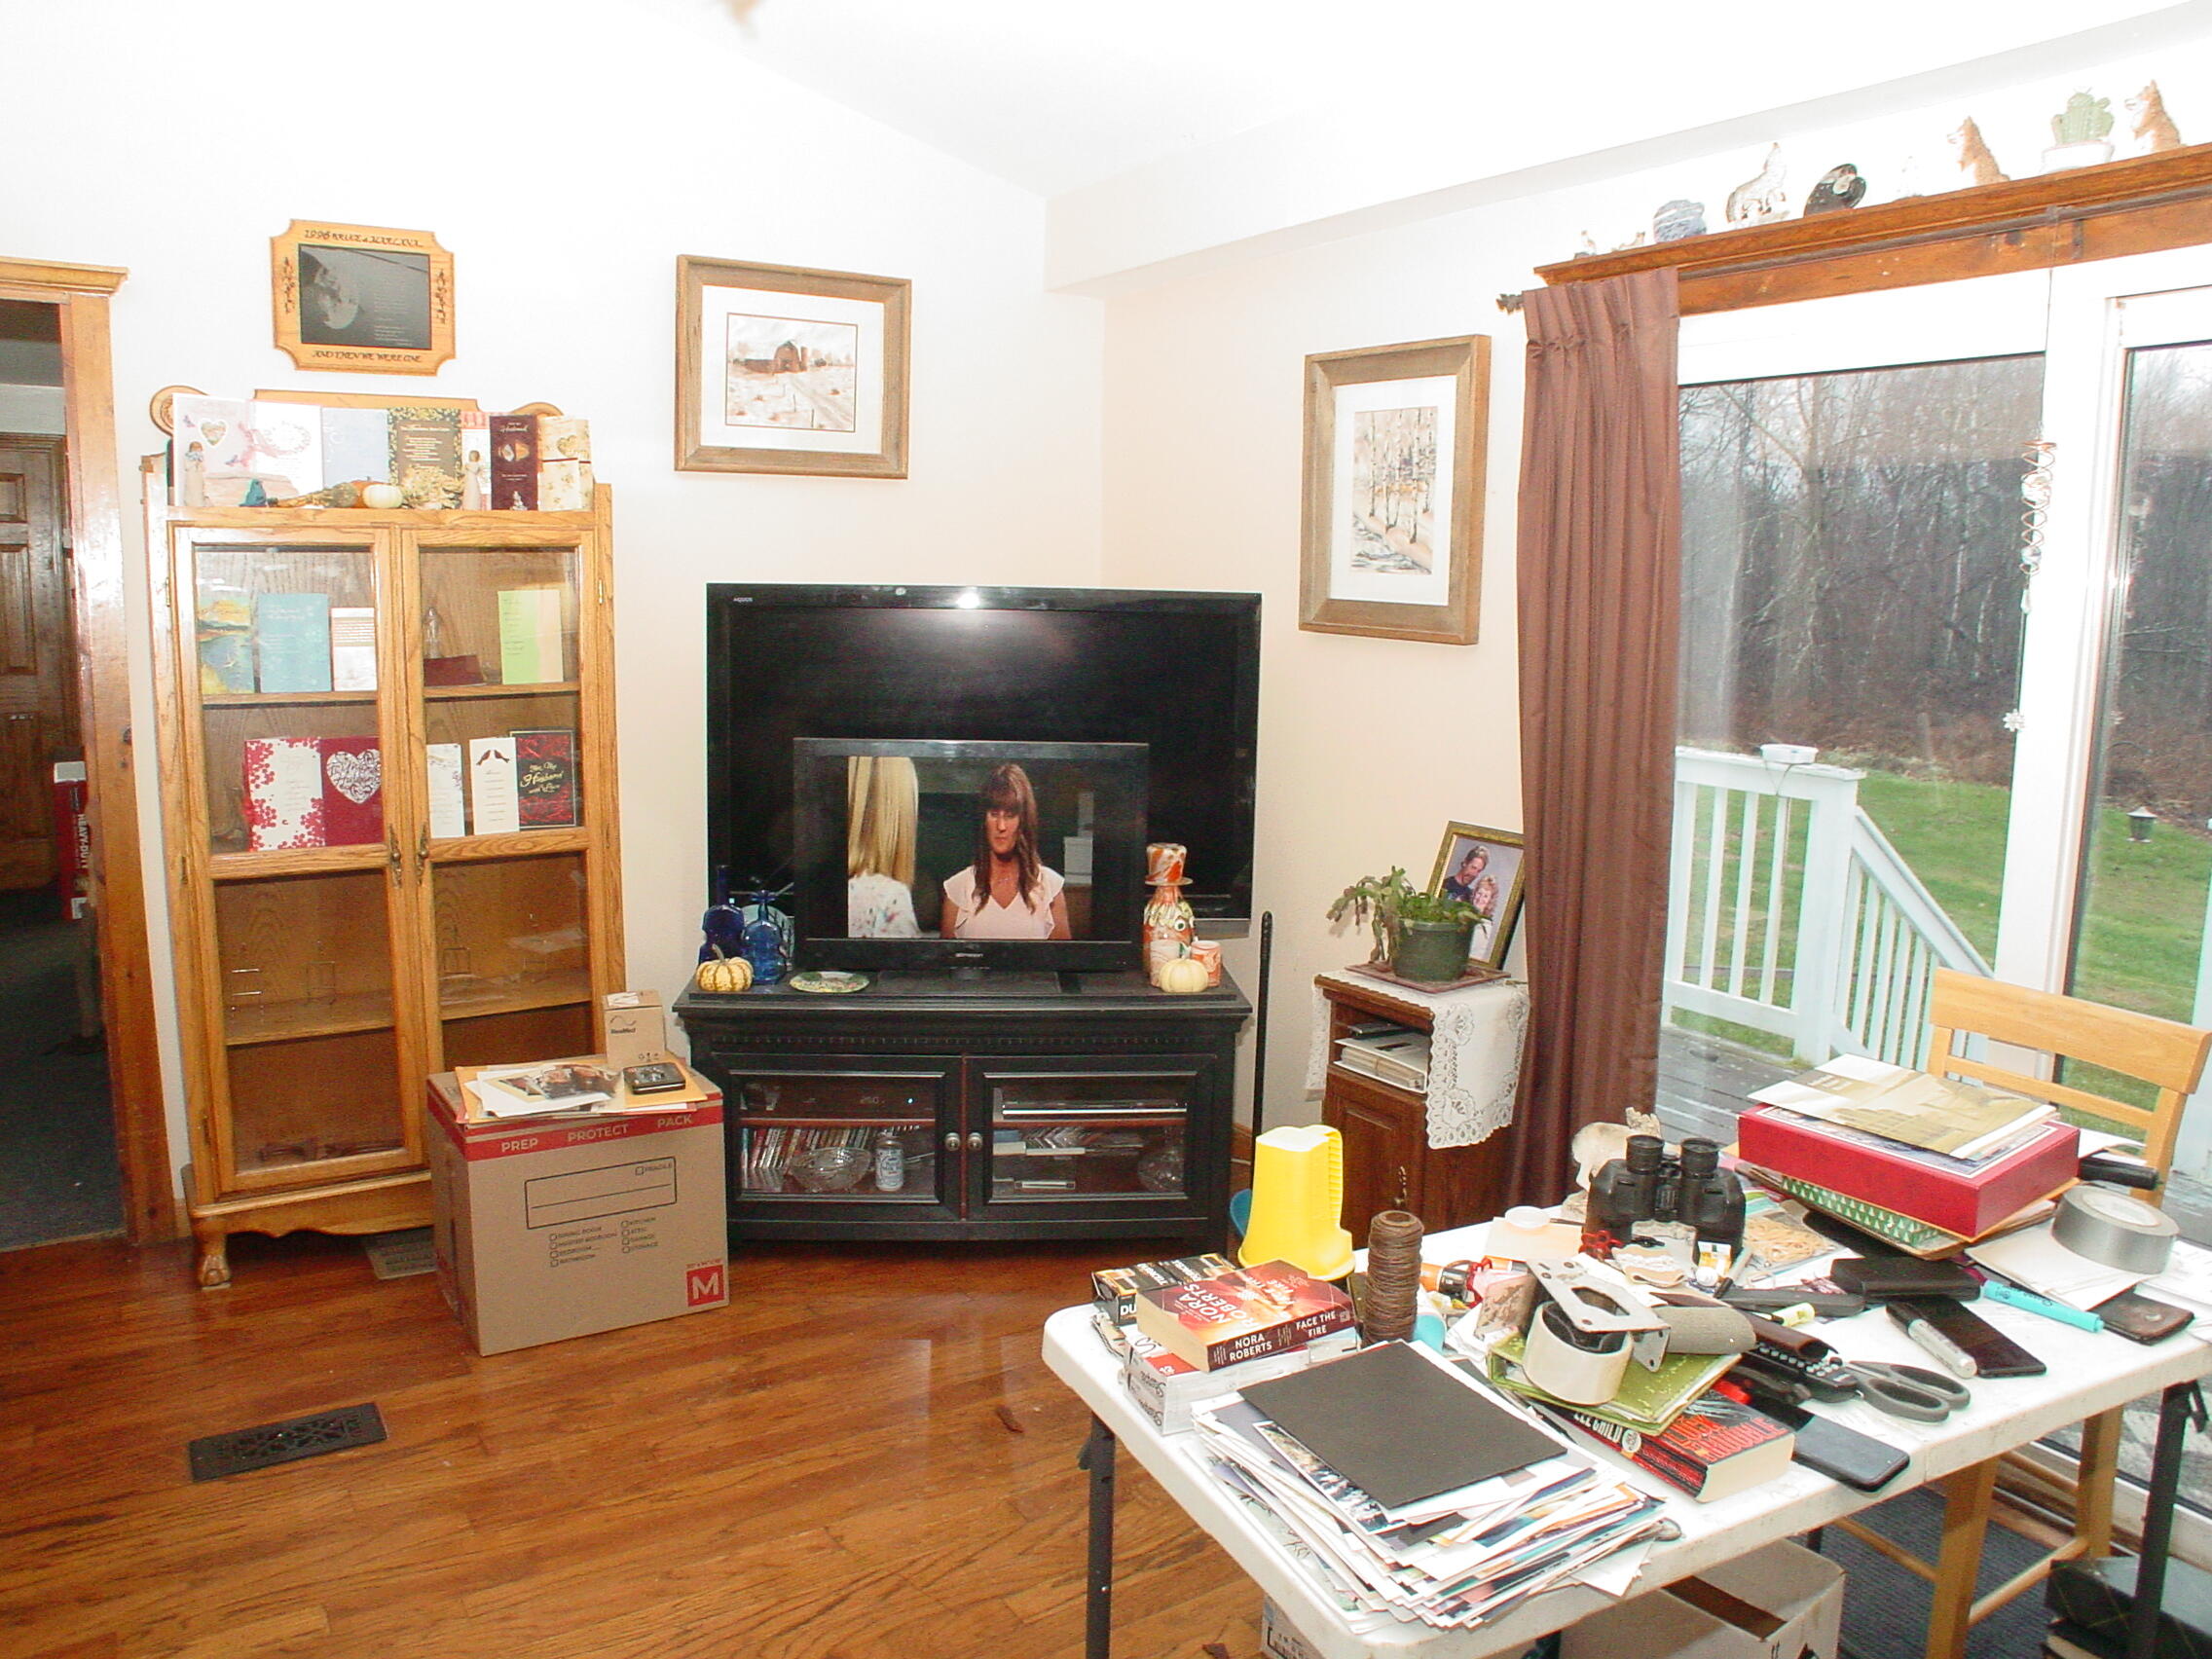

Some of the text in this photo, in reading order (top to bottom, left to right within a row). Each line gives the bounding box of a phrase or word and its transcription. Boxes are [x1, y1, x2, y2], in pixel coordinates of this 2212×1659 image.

[501, 1114, 692, 1153] PREP PROTECT PACK
[692, 1272, 719, 1300] M
[1179, 1293, 1232, 1324] NORA
[1184, 1282, 1259, 1328] ROBERTS
[1296, 1310, 1337, 1330] FACE THE
[1308, 1324, 1327, 1338] FIRE
[1229, 1341, 1272, 1362] ROBERTS
[1235, 1333, 1266, 1349] NORA
[1592, 1419, 1624, 1443] CHILD
